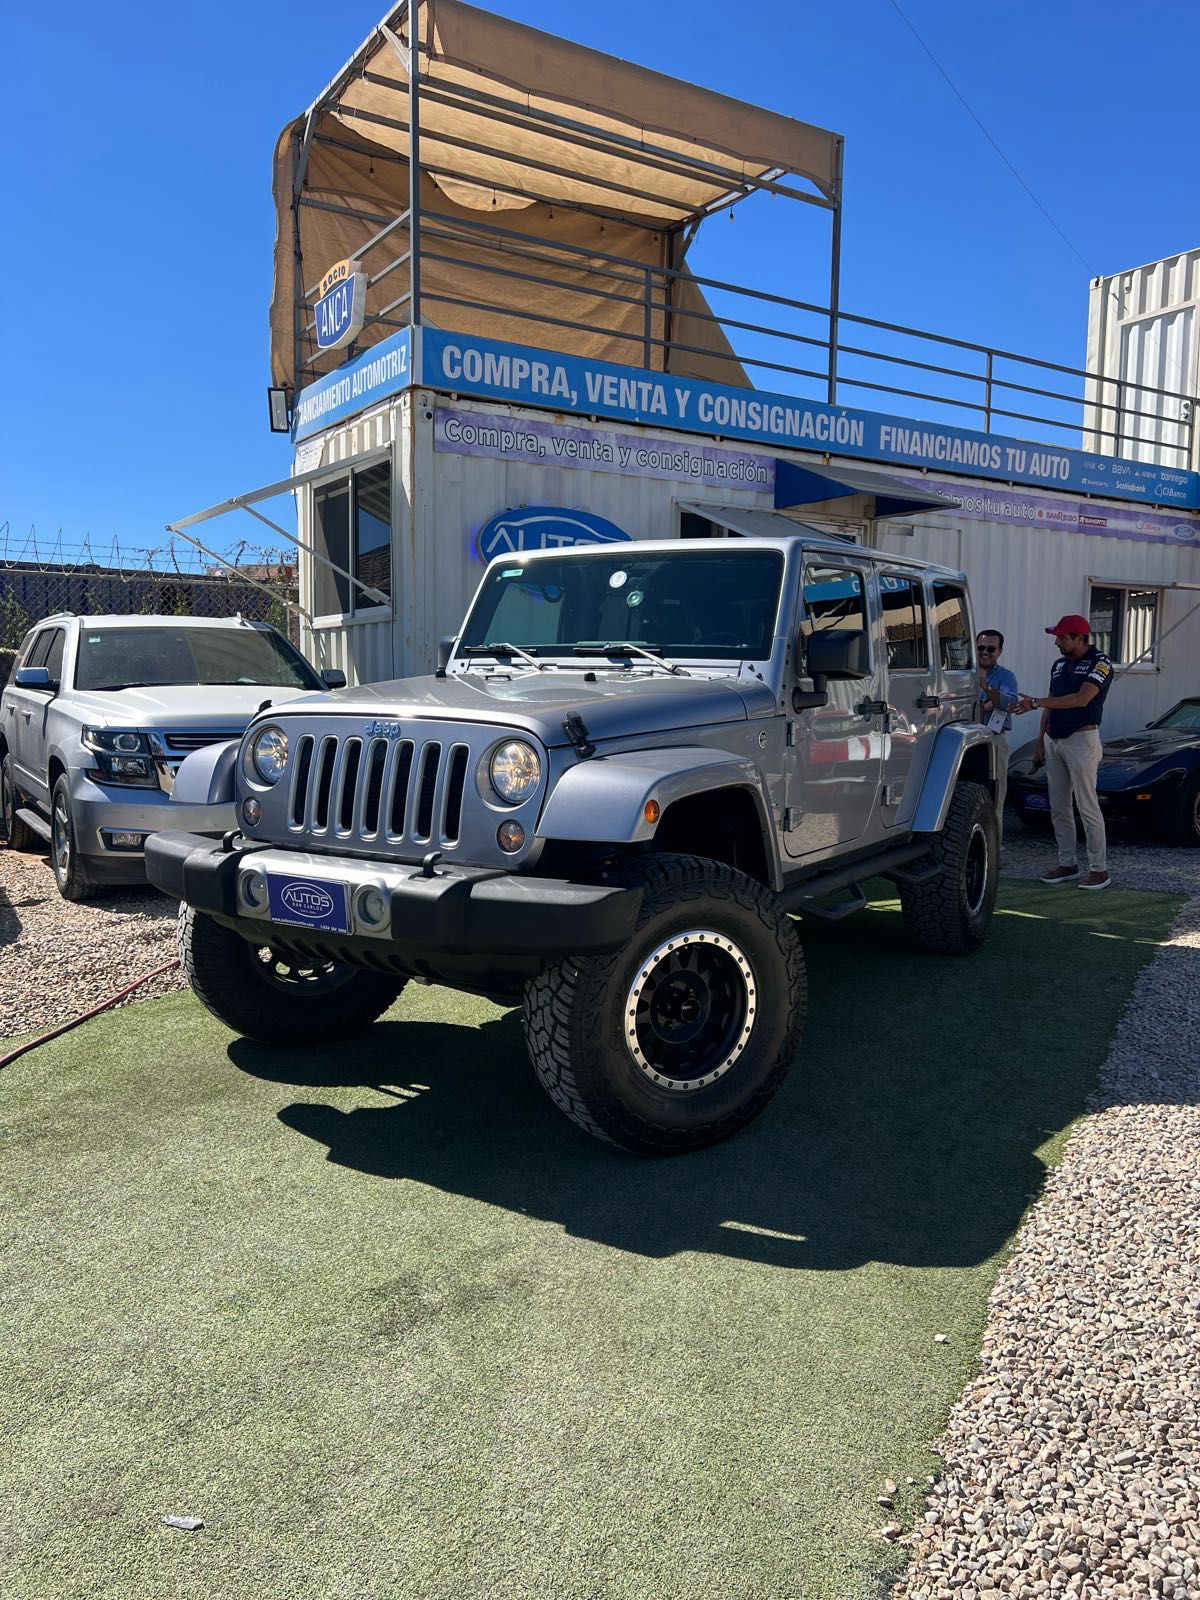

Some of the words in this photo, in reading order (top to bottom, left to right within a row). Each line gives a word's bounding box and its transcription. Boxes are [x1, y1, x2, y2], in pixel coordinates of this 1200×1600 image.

[322, 265, 346, 290] SOCIO
[321, 286, 349, 337] ANCA
[352, 345, 407, 398] AUTOMOTRIZ
[443, 345, 578, 406] COMPRA,
[585, 371, 668, 416] VENTA
[674, 388, 692, 418] Y
[698, 392, 865, 448] CONSIGNACIÓN
[879, 424, 1001, 470] FINANCIAMOS
[1006, 447, 1026, 473] TU
[1030, 453, 1070, 482] AUTO
[444, 418, 546, 457] Compra,
[552, 435, 614, 463] venta
[619, 446, 632, 468] y
[636, 448, 768, 484] consignación
[1003, 501, 1037, 521] auto
[486, 527, 601, 553] AUT
[365, 720, 401, 741] Jeep
[285, 890, 330, 908] AUTOS
